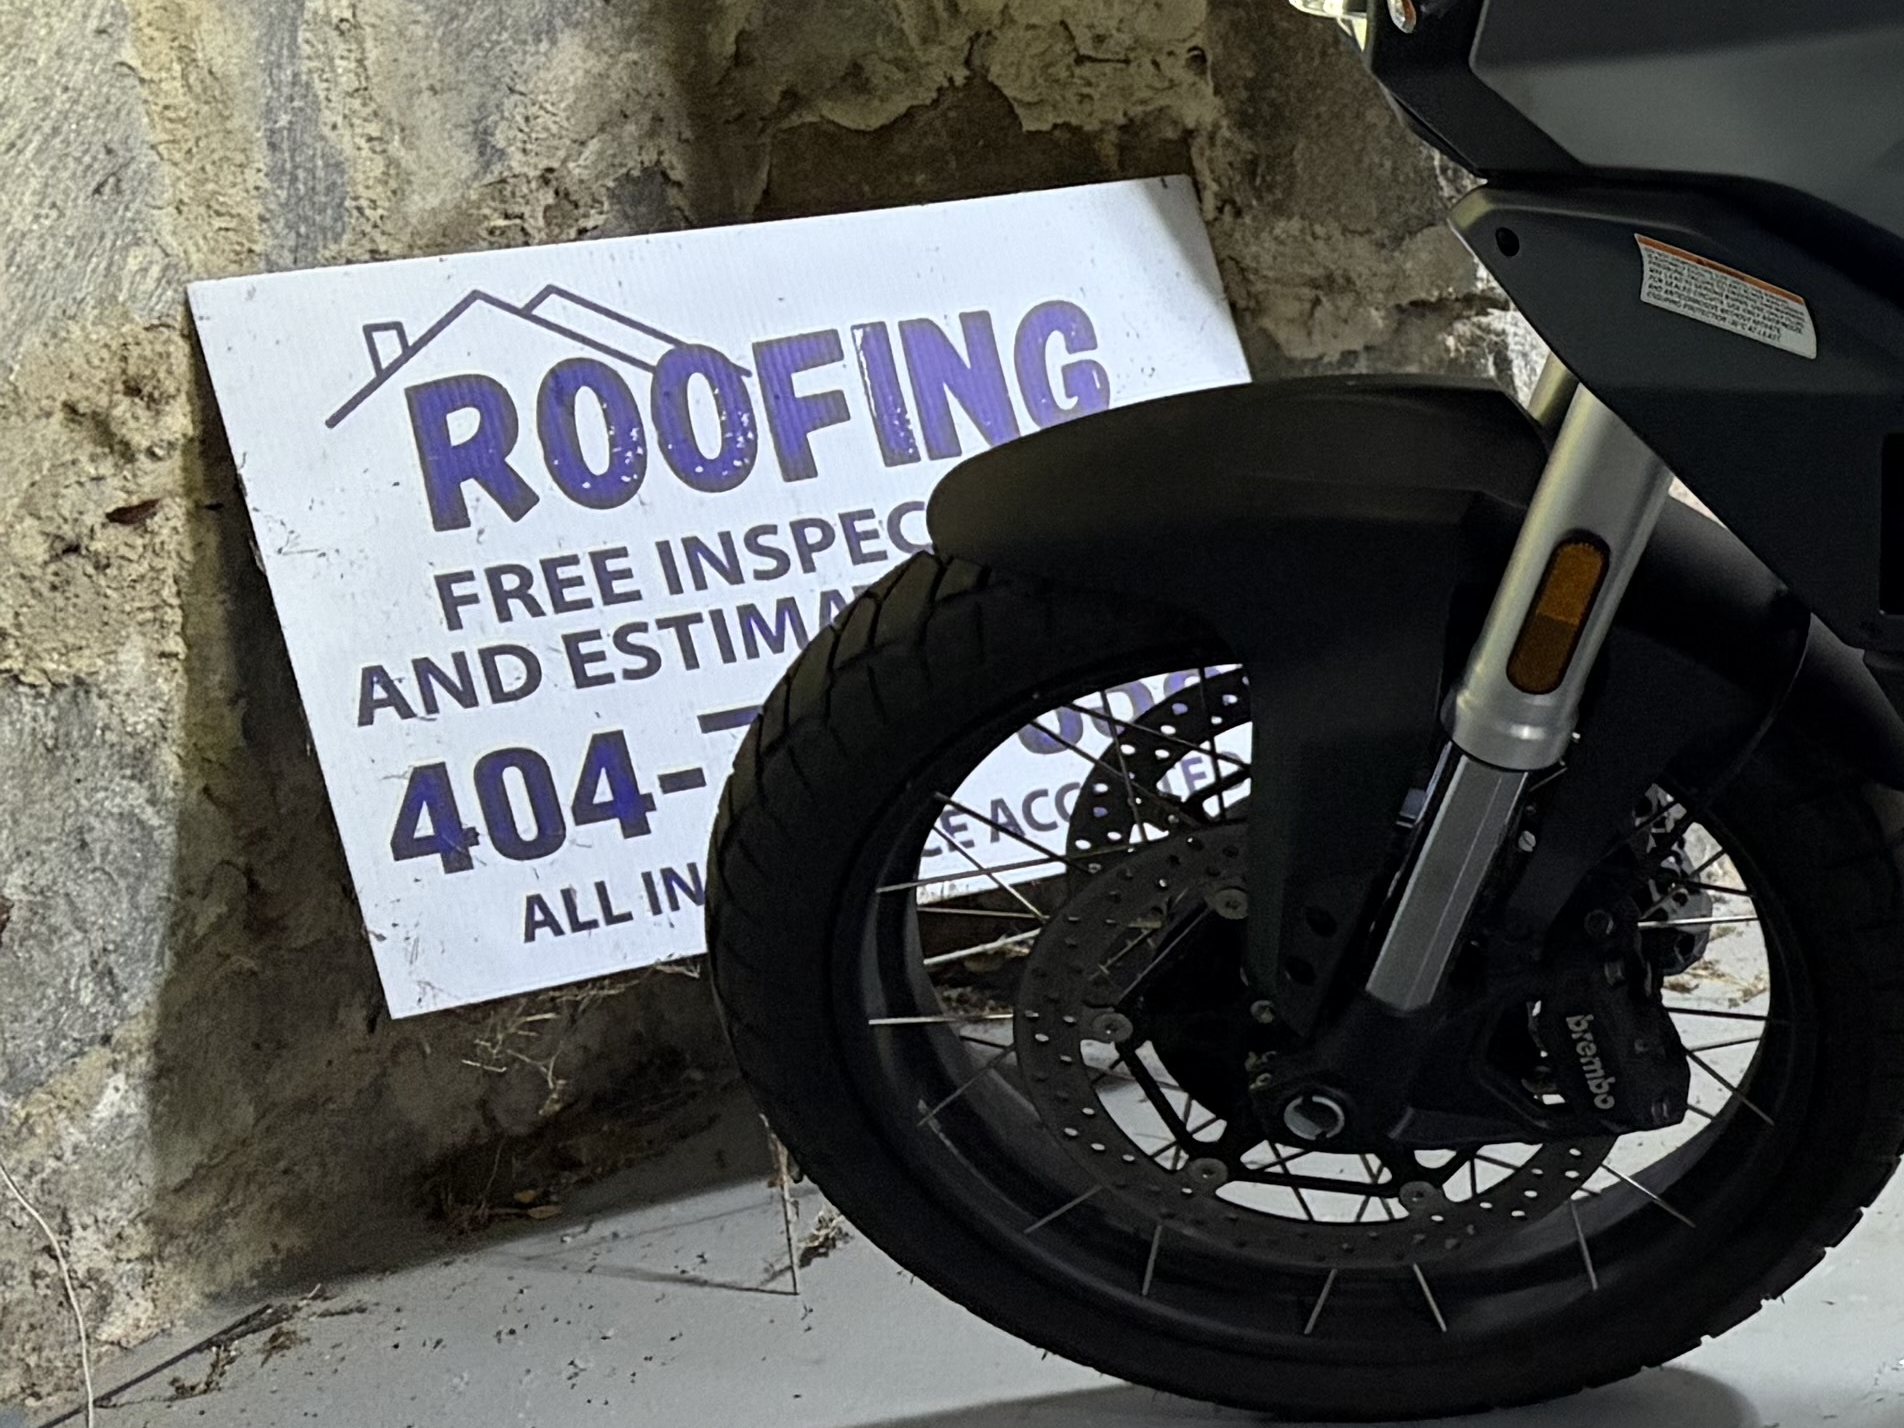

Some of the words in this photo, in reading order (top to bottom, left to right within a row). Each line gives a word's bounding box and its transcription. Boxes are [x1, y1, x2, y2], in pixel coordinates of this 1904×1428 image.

[404, 300, 1111, 532] ROOFING
[434, 546, 643, 631] FREE
[654, 500, 936, 596] INSPEC
[357, 644, 543, 727] AND
[561, 584, 872, 690] ESTIMA
[389, 704, 764, 875] 404-
[523, 880, 634, 944] ALL
[1566, 1013, 1616, 1110] brembo
